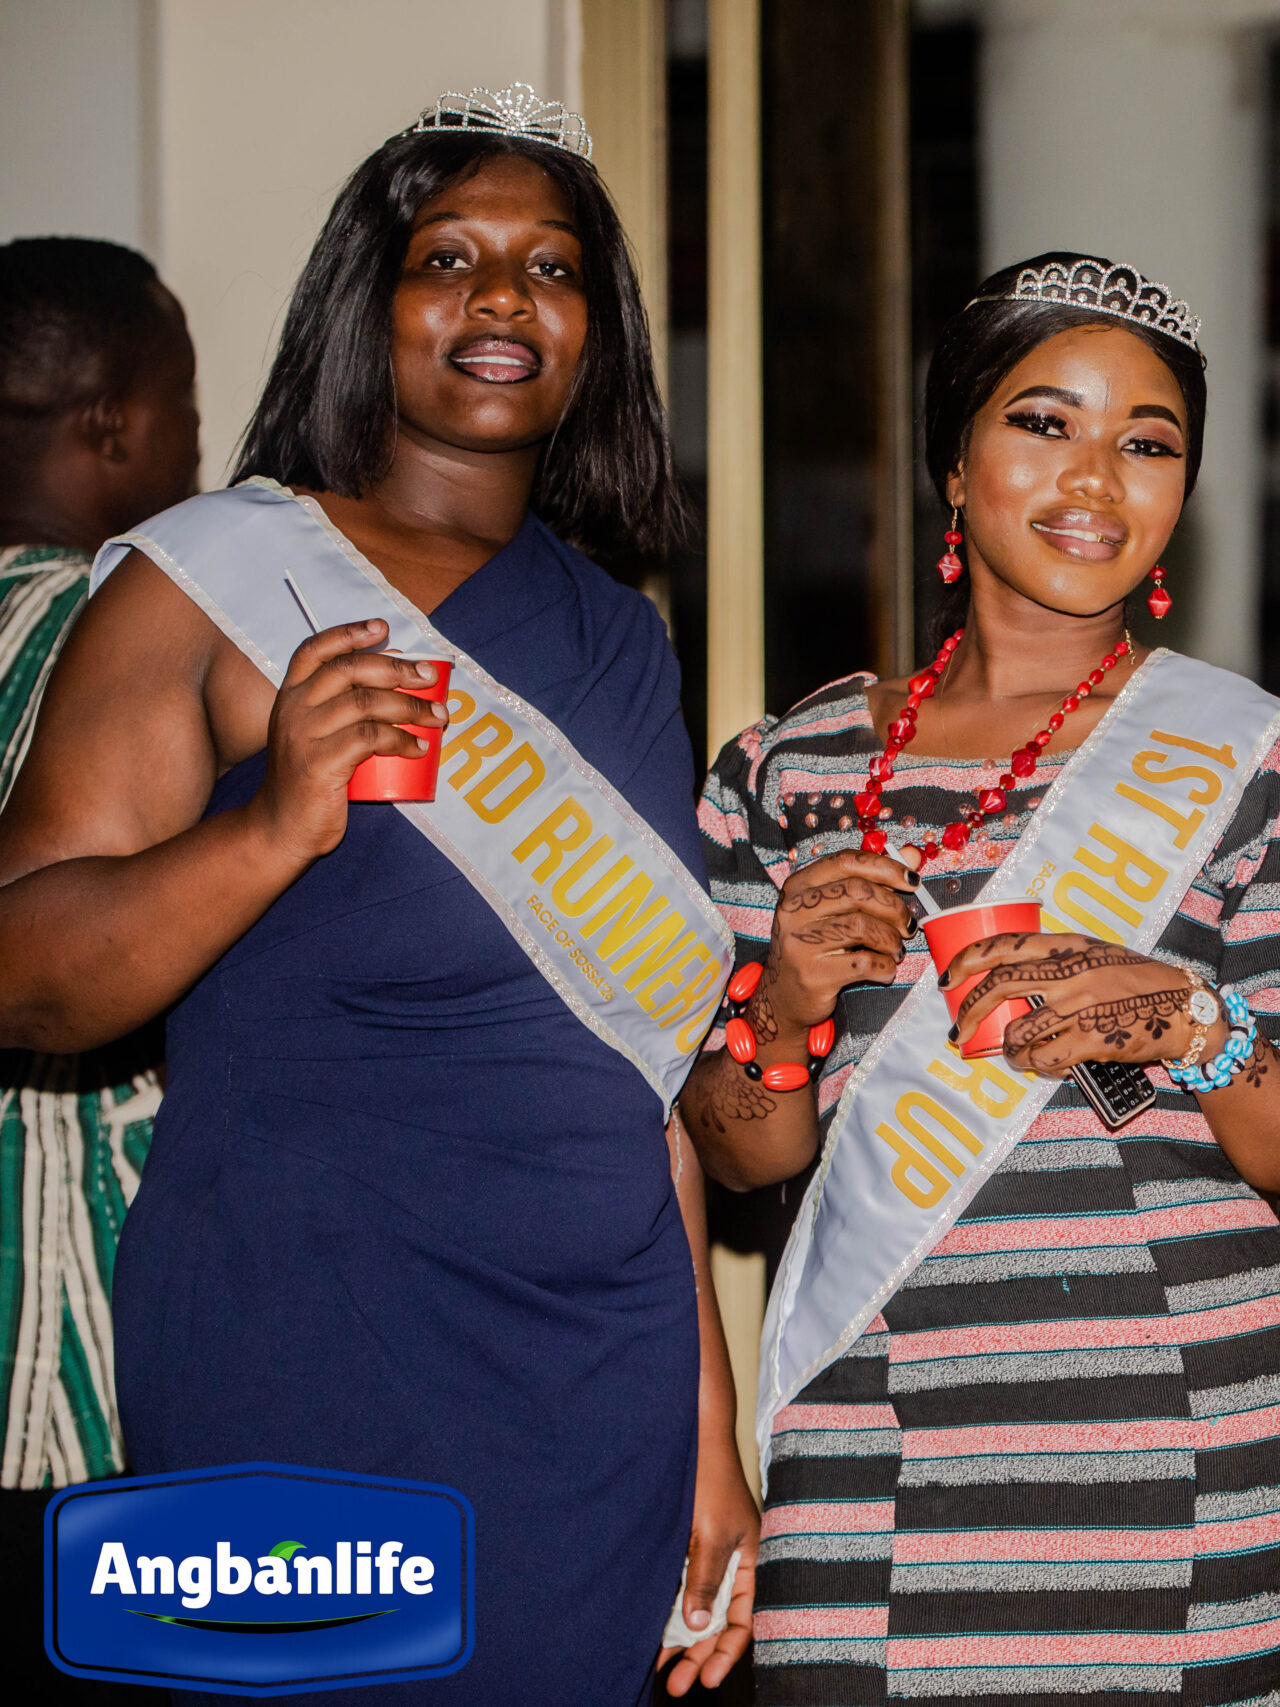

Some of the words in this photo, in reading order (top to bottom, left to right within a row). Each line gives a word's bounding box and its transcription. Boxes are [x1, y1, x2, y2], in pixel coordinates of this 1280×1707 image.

[1114, 728, 1239, 852] 1ST
[511, 796, 721, 1030] RUNNER
[1024, 859, 1057, 899] FACE
[526, 894, 560, 933] FACE
[554, 929, 576, 949] OF
[569, 947, 617, 1003] SOSSA'26
[873, 1090, 985, 1210] UP
